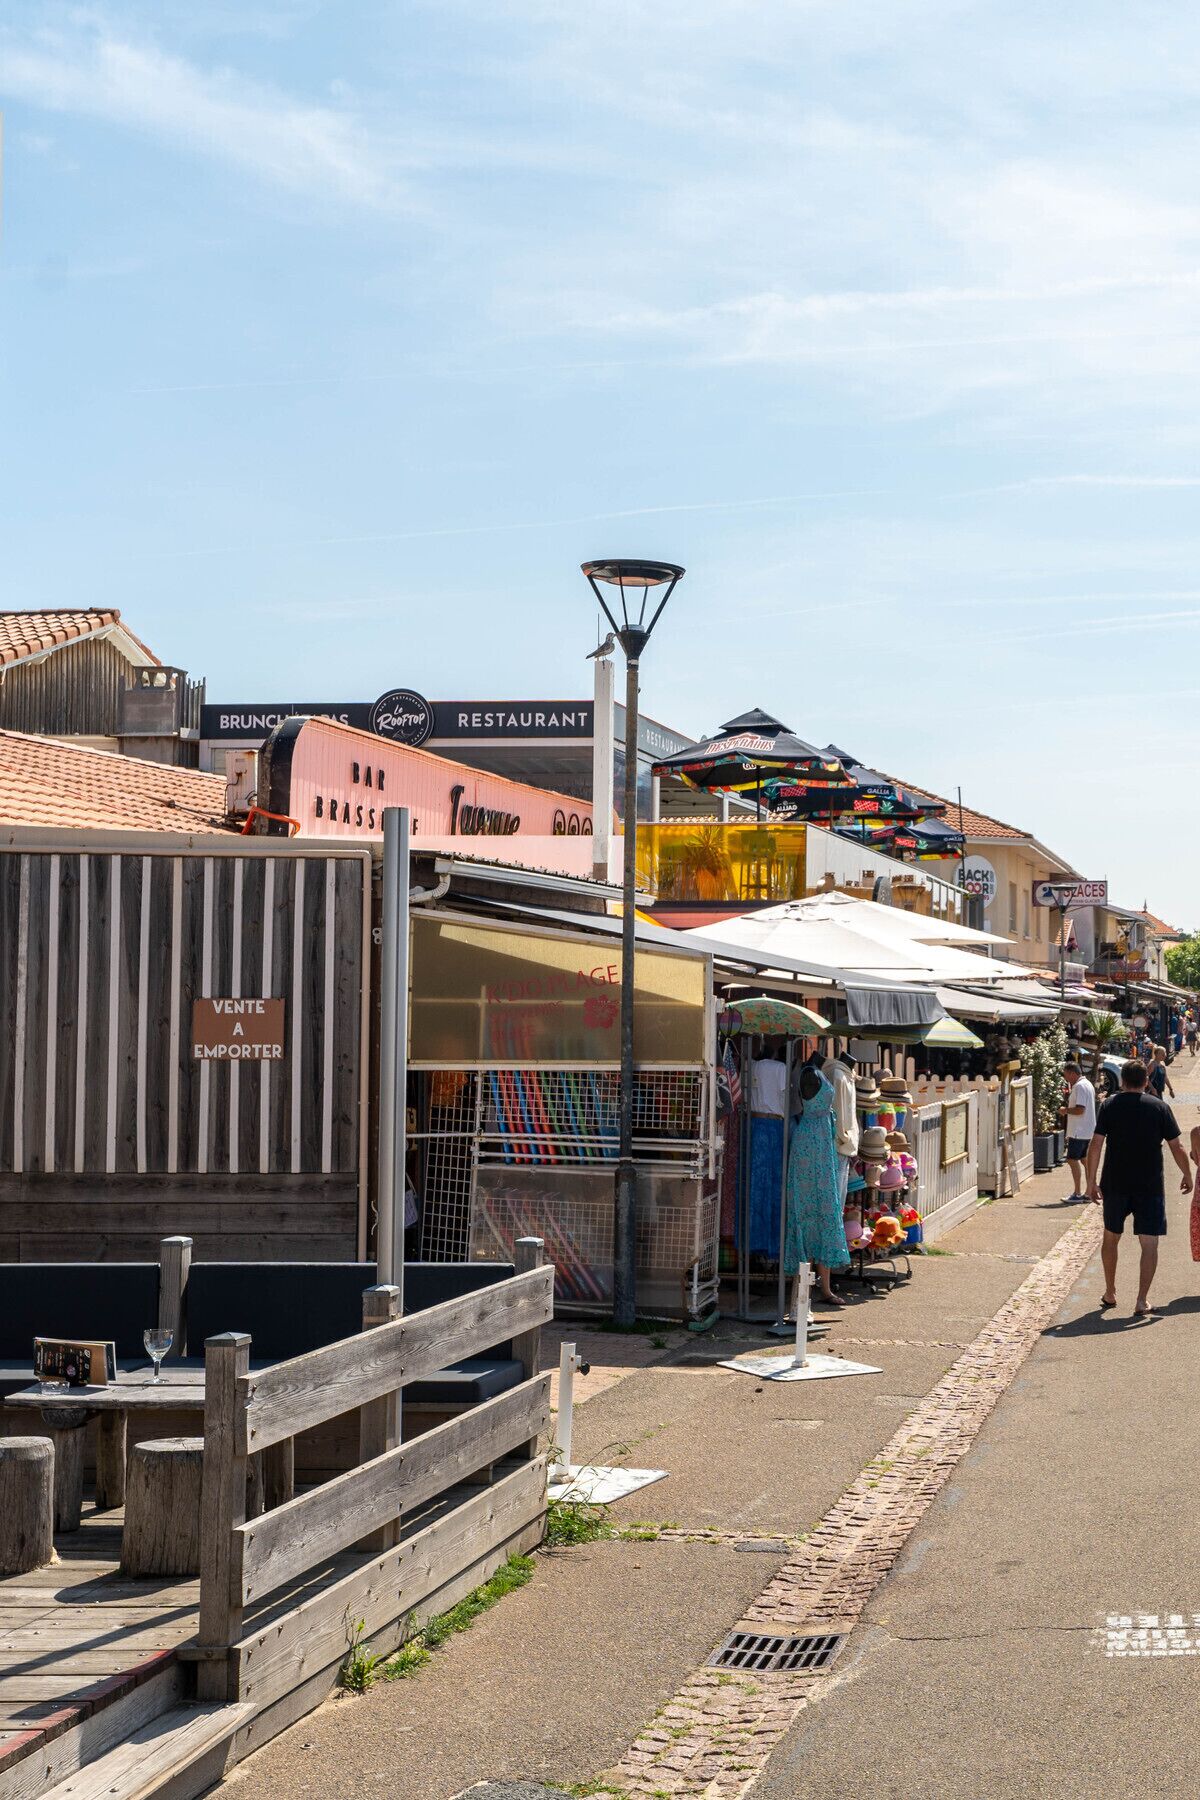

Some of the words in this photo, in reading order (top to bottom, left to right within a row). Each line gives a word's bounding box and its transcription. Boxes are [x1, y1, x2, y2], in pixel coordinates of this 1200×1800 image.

[393, 704, 403, 715] Le
[458, 712, 588, 728] RESTAURANT
[352, 762, 385, 791] BAR
[315, 796, 419, 836] BRASSE
[958, 869, 989, 882] BACK
[549, 964, 620, 994] PLAGE
[212, 1000, 265, 1014] VENTE
[232, 1022, 244, 1036] A
[194, 1044, 282, 1059] EMPORTER
